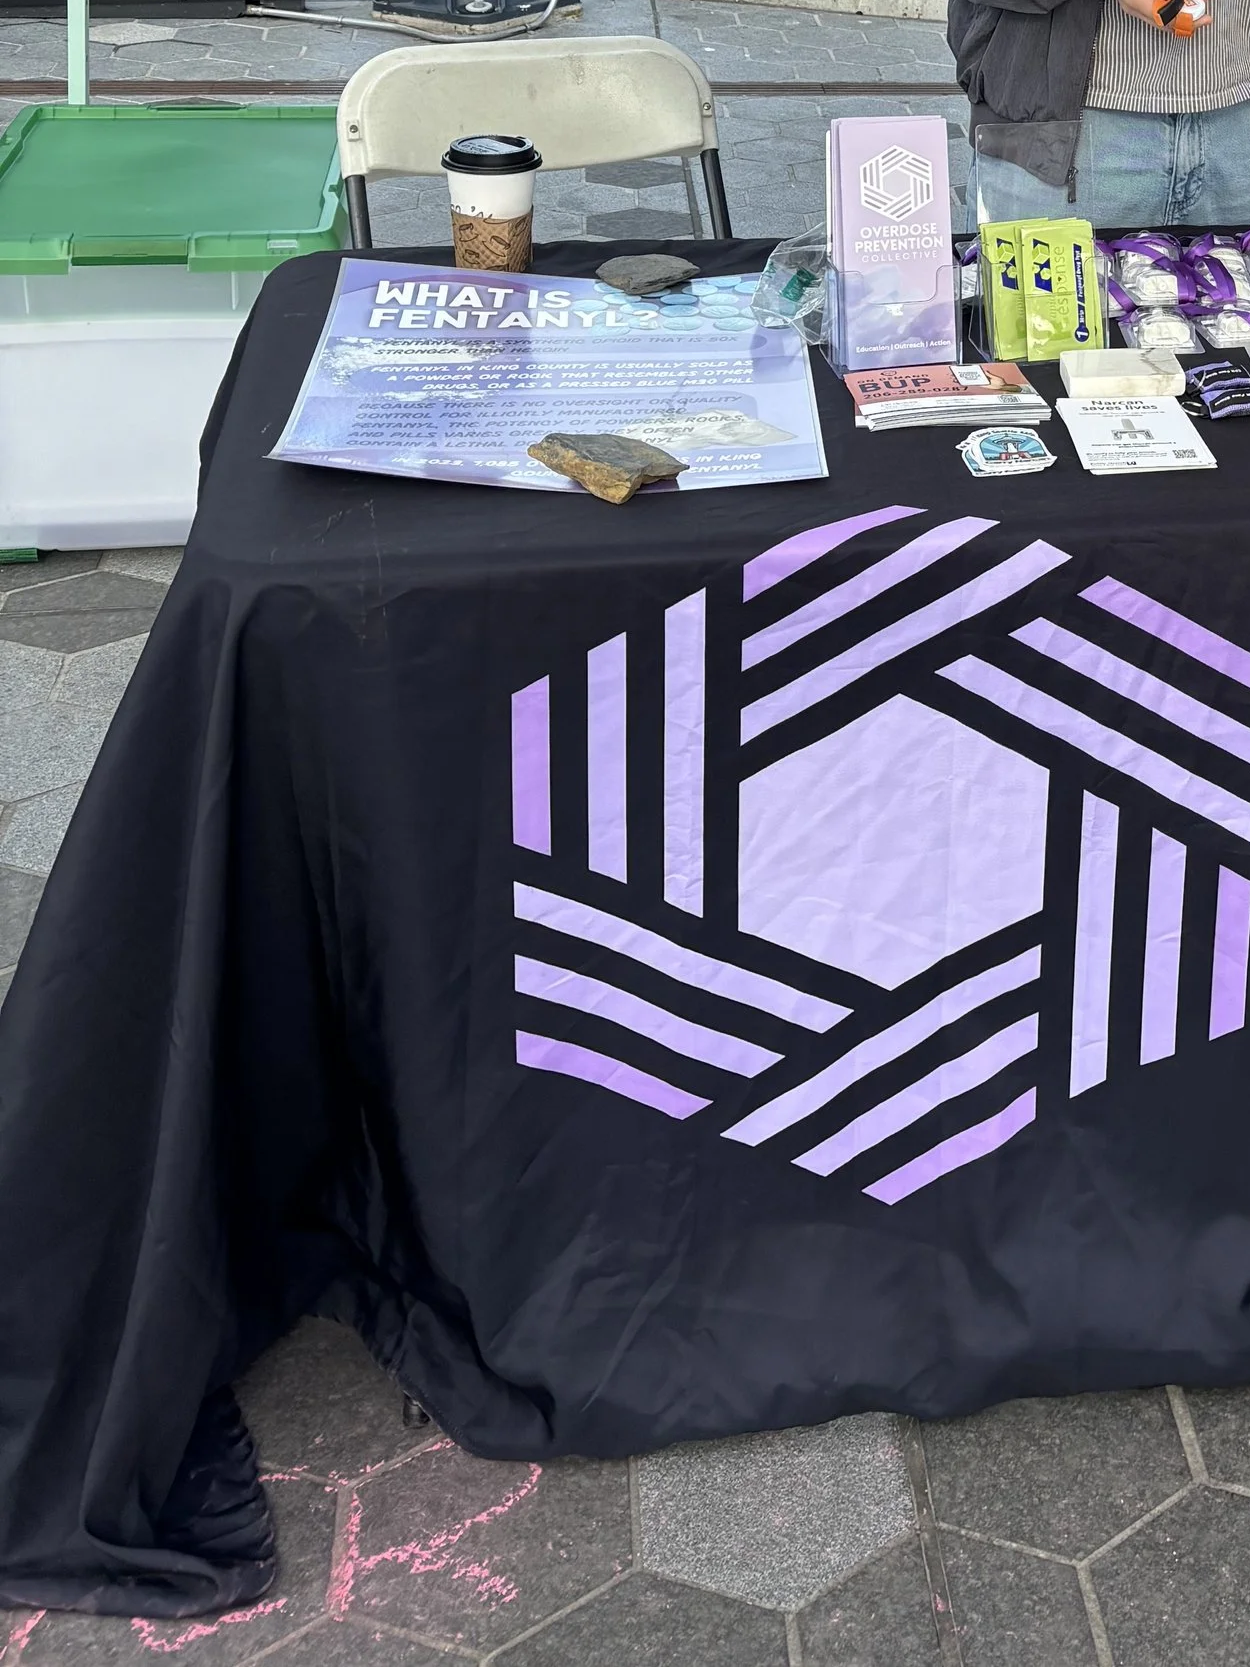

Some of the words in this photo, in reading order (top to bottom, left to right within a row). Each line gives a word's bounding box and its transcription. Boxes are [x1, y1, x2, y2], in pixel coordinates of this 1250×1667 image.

[860, 223, 936, 238] OVERDOSE
[855, 236, 944, 253] PREVENTION
[862, 250, 938, 263] COLLECTIVE
[374, 280, 514, 309] WHAT
[528, 288, 572, 310] IS
[368, 308, 660, 329] FENTANYL?
[382, 338, 460, 346] FENTANYL
[466, 338, 482, 346] IS
[484, 338, 497, 346] A
[856, 343, 890, 353] Education
[894, 341, 924, 351] Outreach
[930, 339, 951, 348] Action
[370, 364, 451, 373] FENTANYL
[688, 360, 728, 368] SOLD
[506, 372, 554, 380] ROCK
[604, 370, 698, 378] RESEMBLES
[704, 368, 754, 376] OTHER
[879, 374, 929, 382] DEMAND
[558, 380, 634, 388] PRESSED
[636, 379, 680, 387] BLUE
[685, 378, 717, 386] M30
[858, 378, 931, 393] BUP
[864, 386, 969, 399] 206-289-0287
[358, 402, 436, 410] BECAUSE
[522, 400, 547, 408] NO
[552, 398, 644, 406] OVERSIGHT
[676, 396, 742, 404] QUALITY
[477, 410, 554, 418] ILLICITLY
[558, 408, 686, 416] MANUFACTURED
